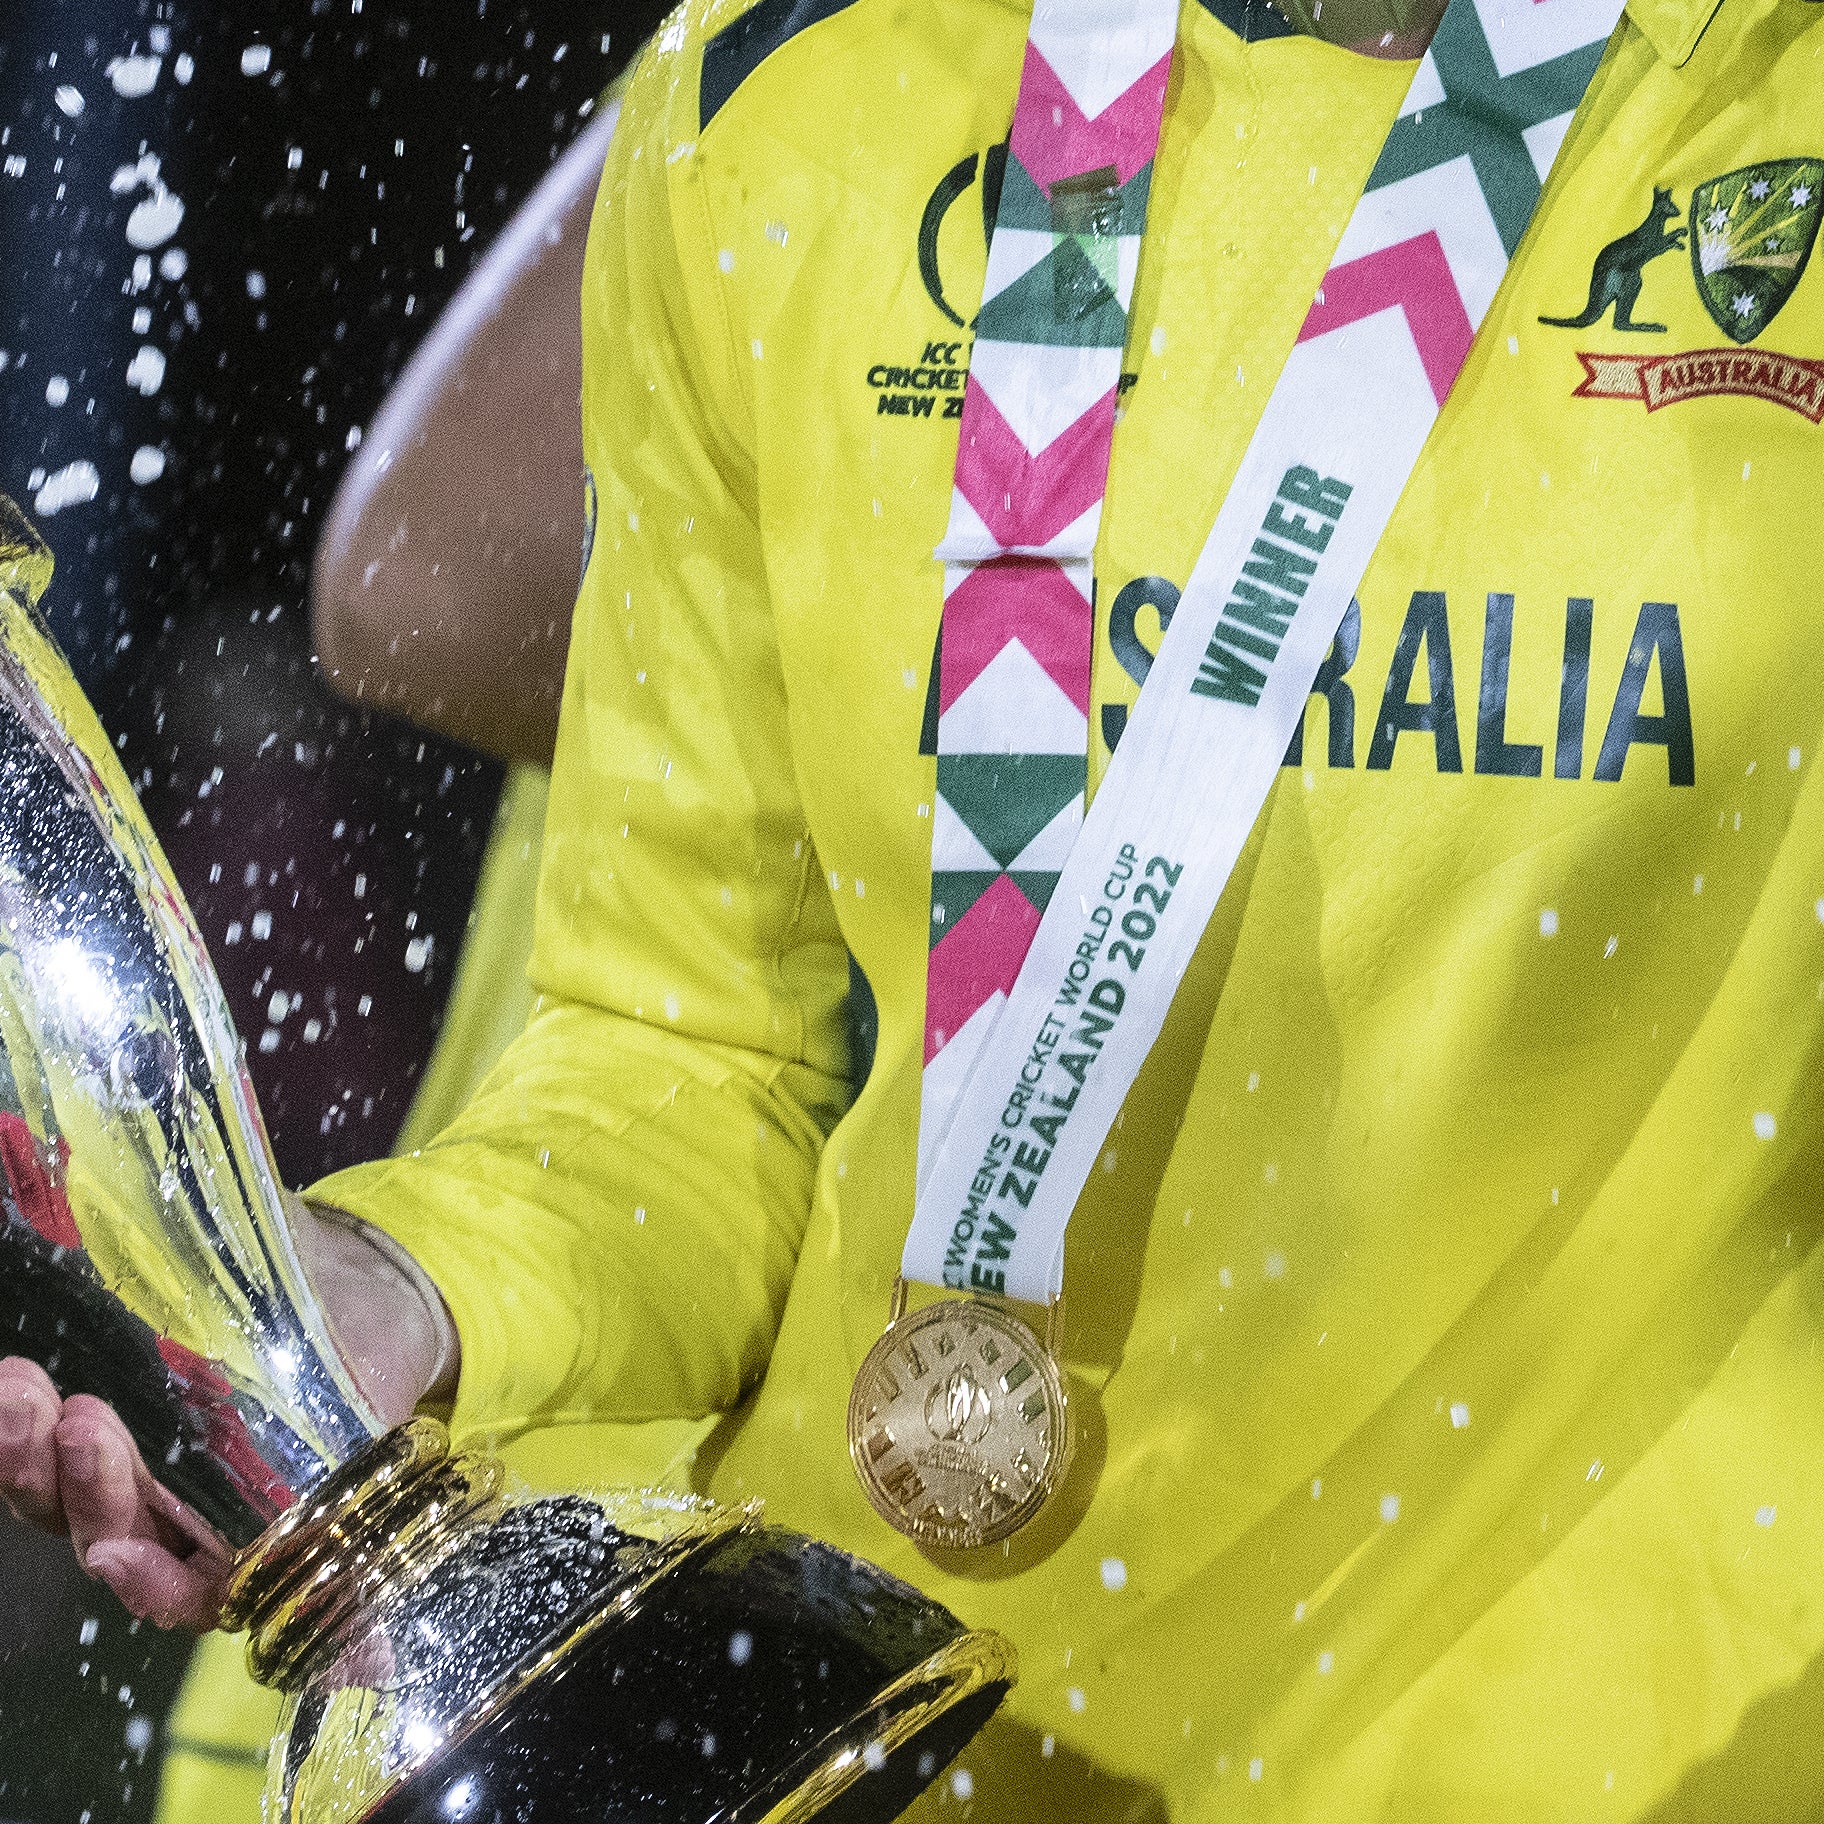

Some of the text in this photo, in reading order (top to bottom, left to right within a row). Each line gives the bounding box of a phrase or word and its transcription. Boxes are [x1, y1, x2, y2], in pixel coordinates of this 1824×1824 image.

[876, 394, 936, 418] NEW
[920, 341, 962, 366] ICC
[1659, 360, 1817, 401] AUSTRALIA
[1189, 461, 1354, 707] WINNER
[945, 1133, 1011, 1270] WOMEN'S
[1001, 1012, 1066, 1130] CRICKET
[1054, 905, 1112, 1007] WORLD
[1104, 842, 1142, 898] CUP
[970, 854, 1185, 1293] EW ZEALAND 2022
